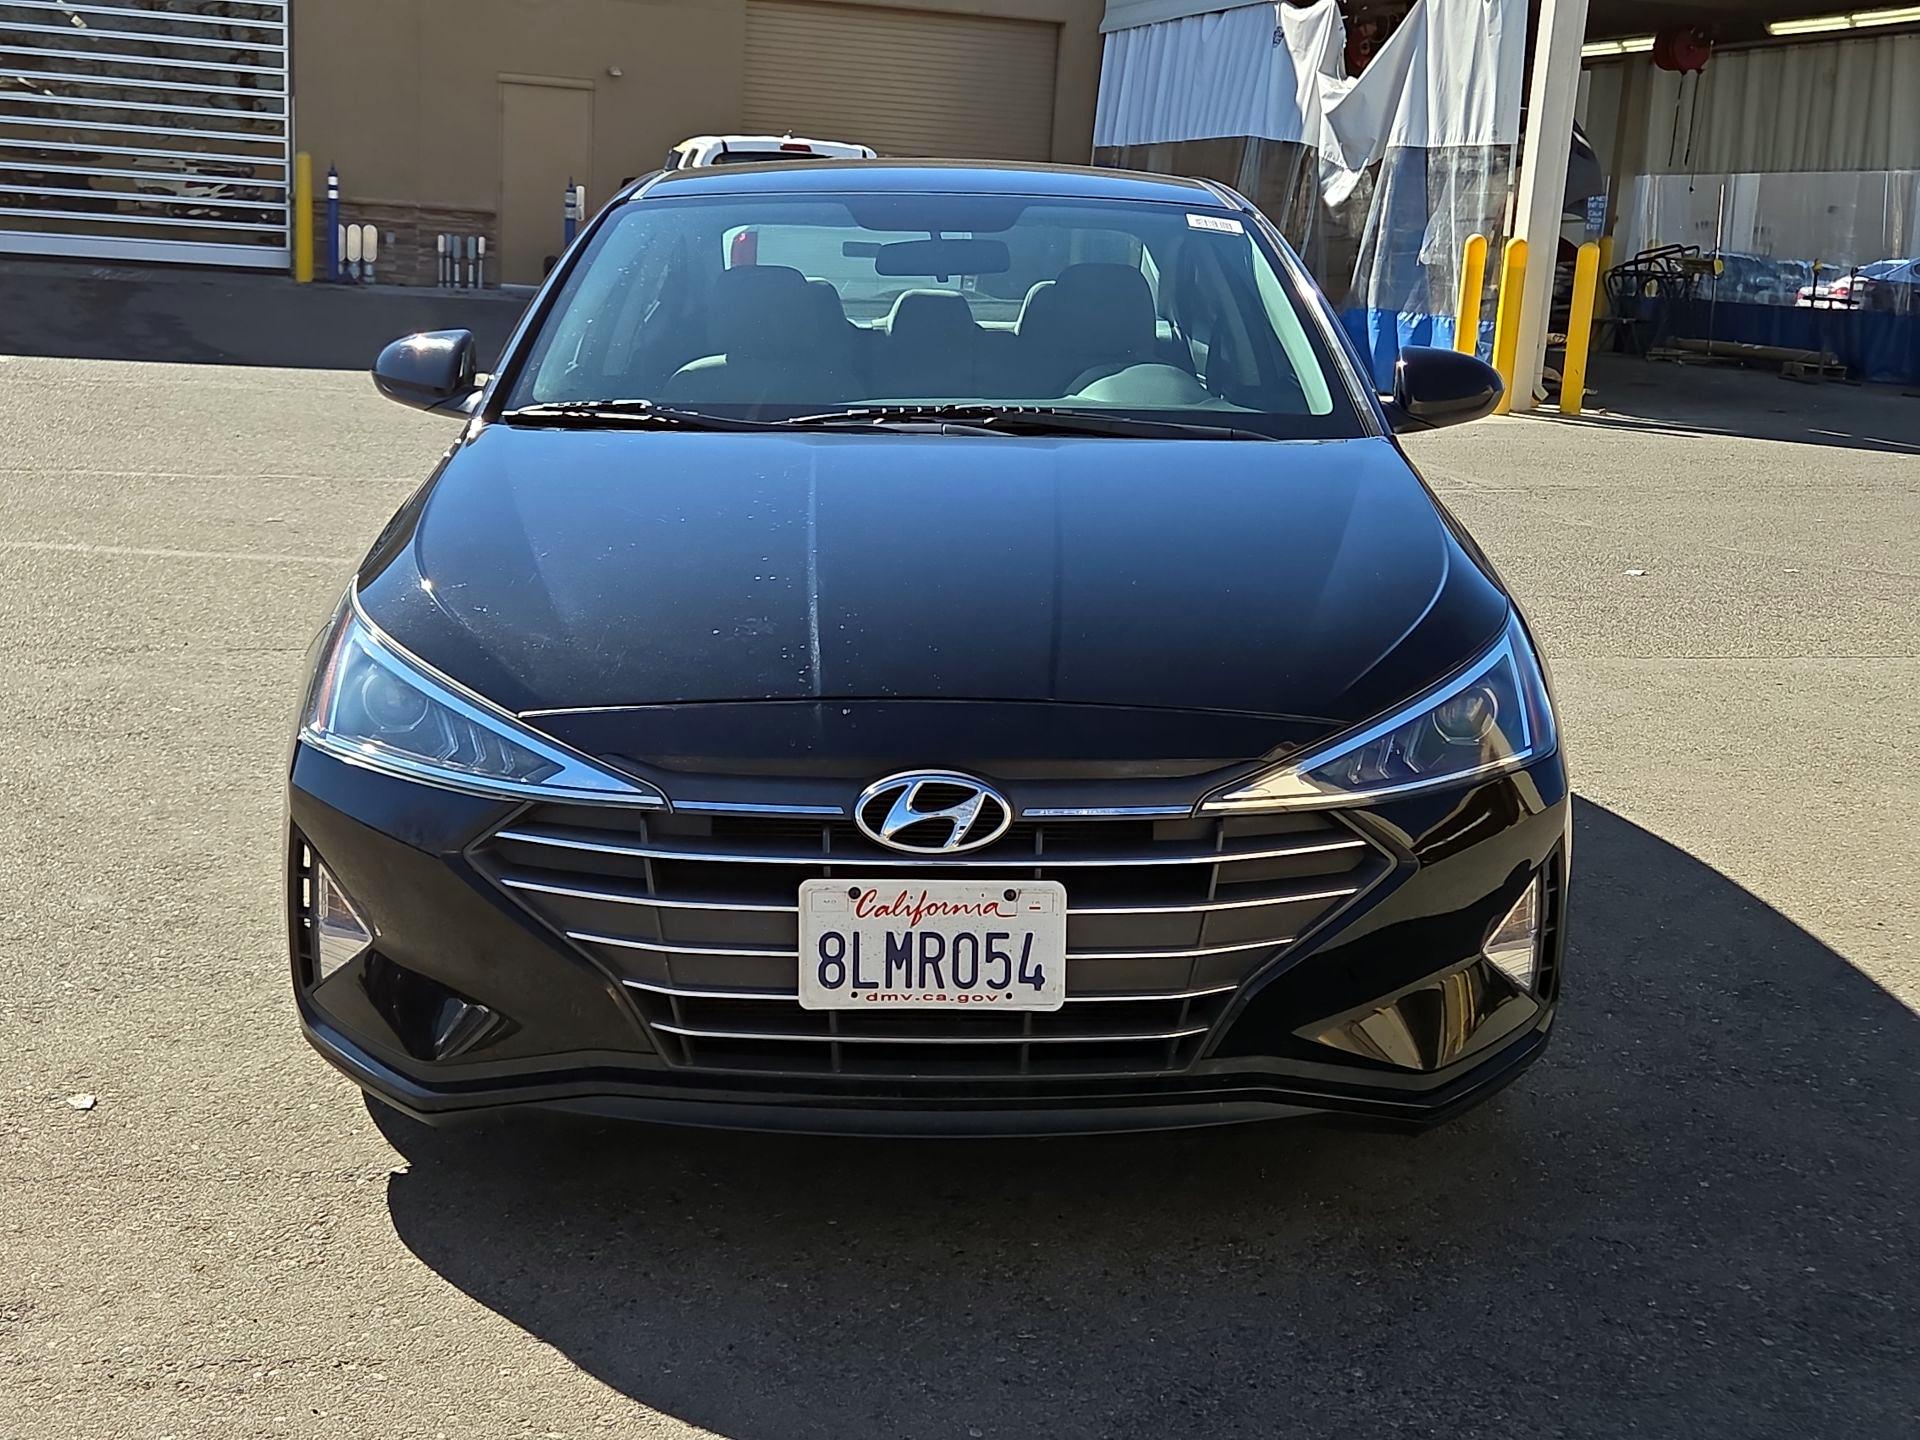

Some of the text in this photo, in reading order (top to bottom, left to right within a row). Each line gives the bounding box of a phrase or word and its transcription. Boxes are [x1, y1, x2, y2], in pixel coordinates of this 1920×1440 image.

[855, 889, 1017, 927] California
[818, 931, 1045, 991] 8LMR054
[866, 992, 998, 1003] dmv.ca.gov
